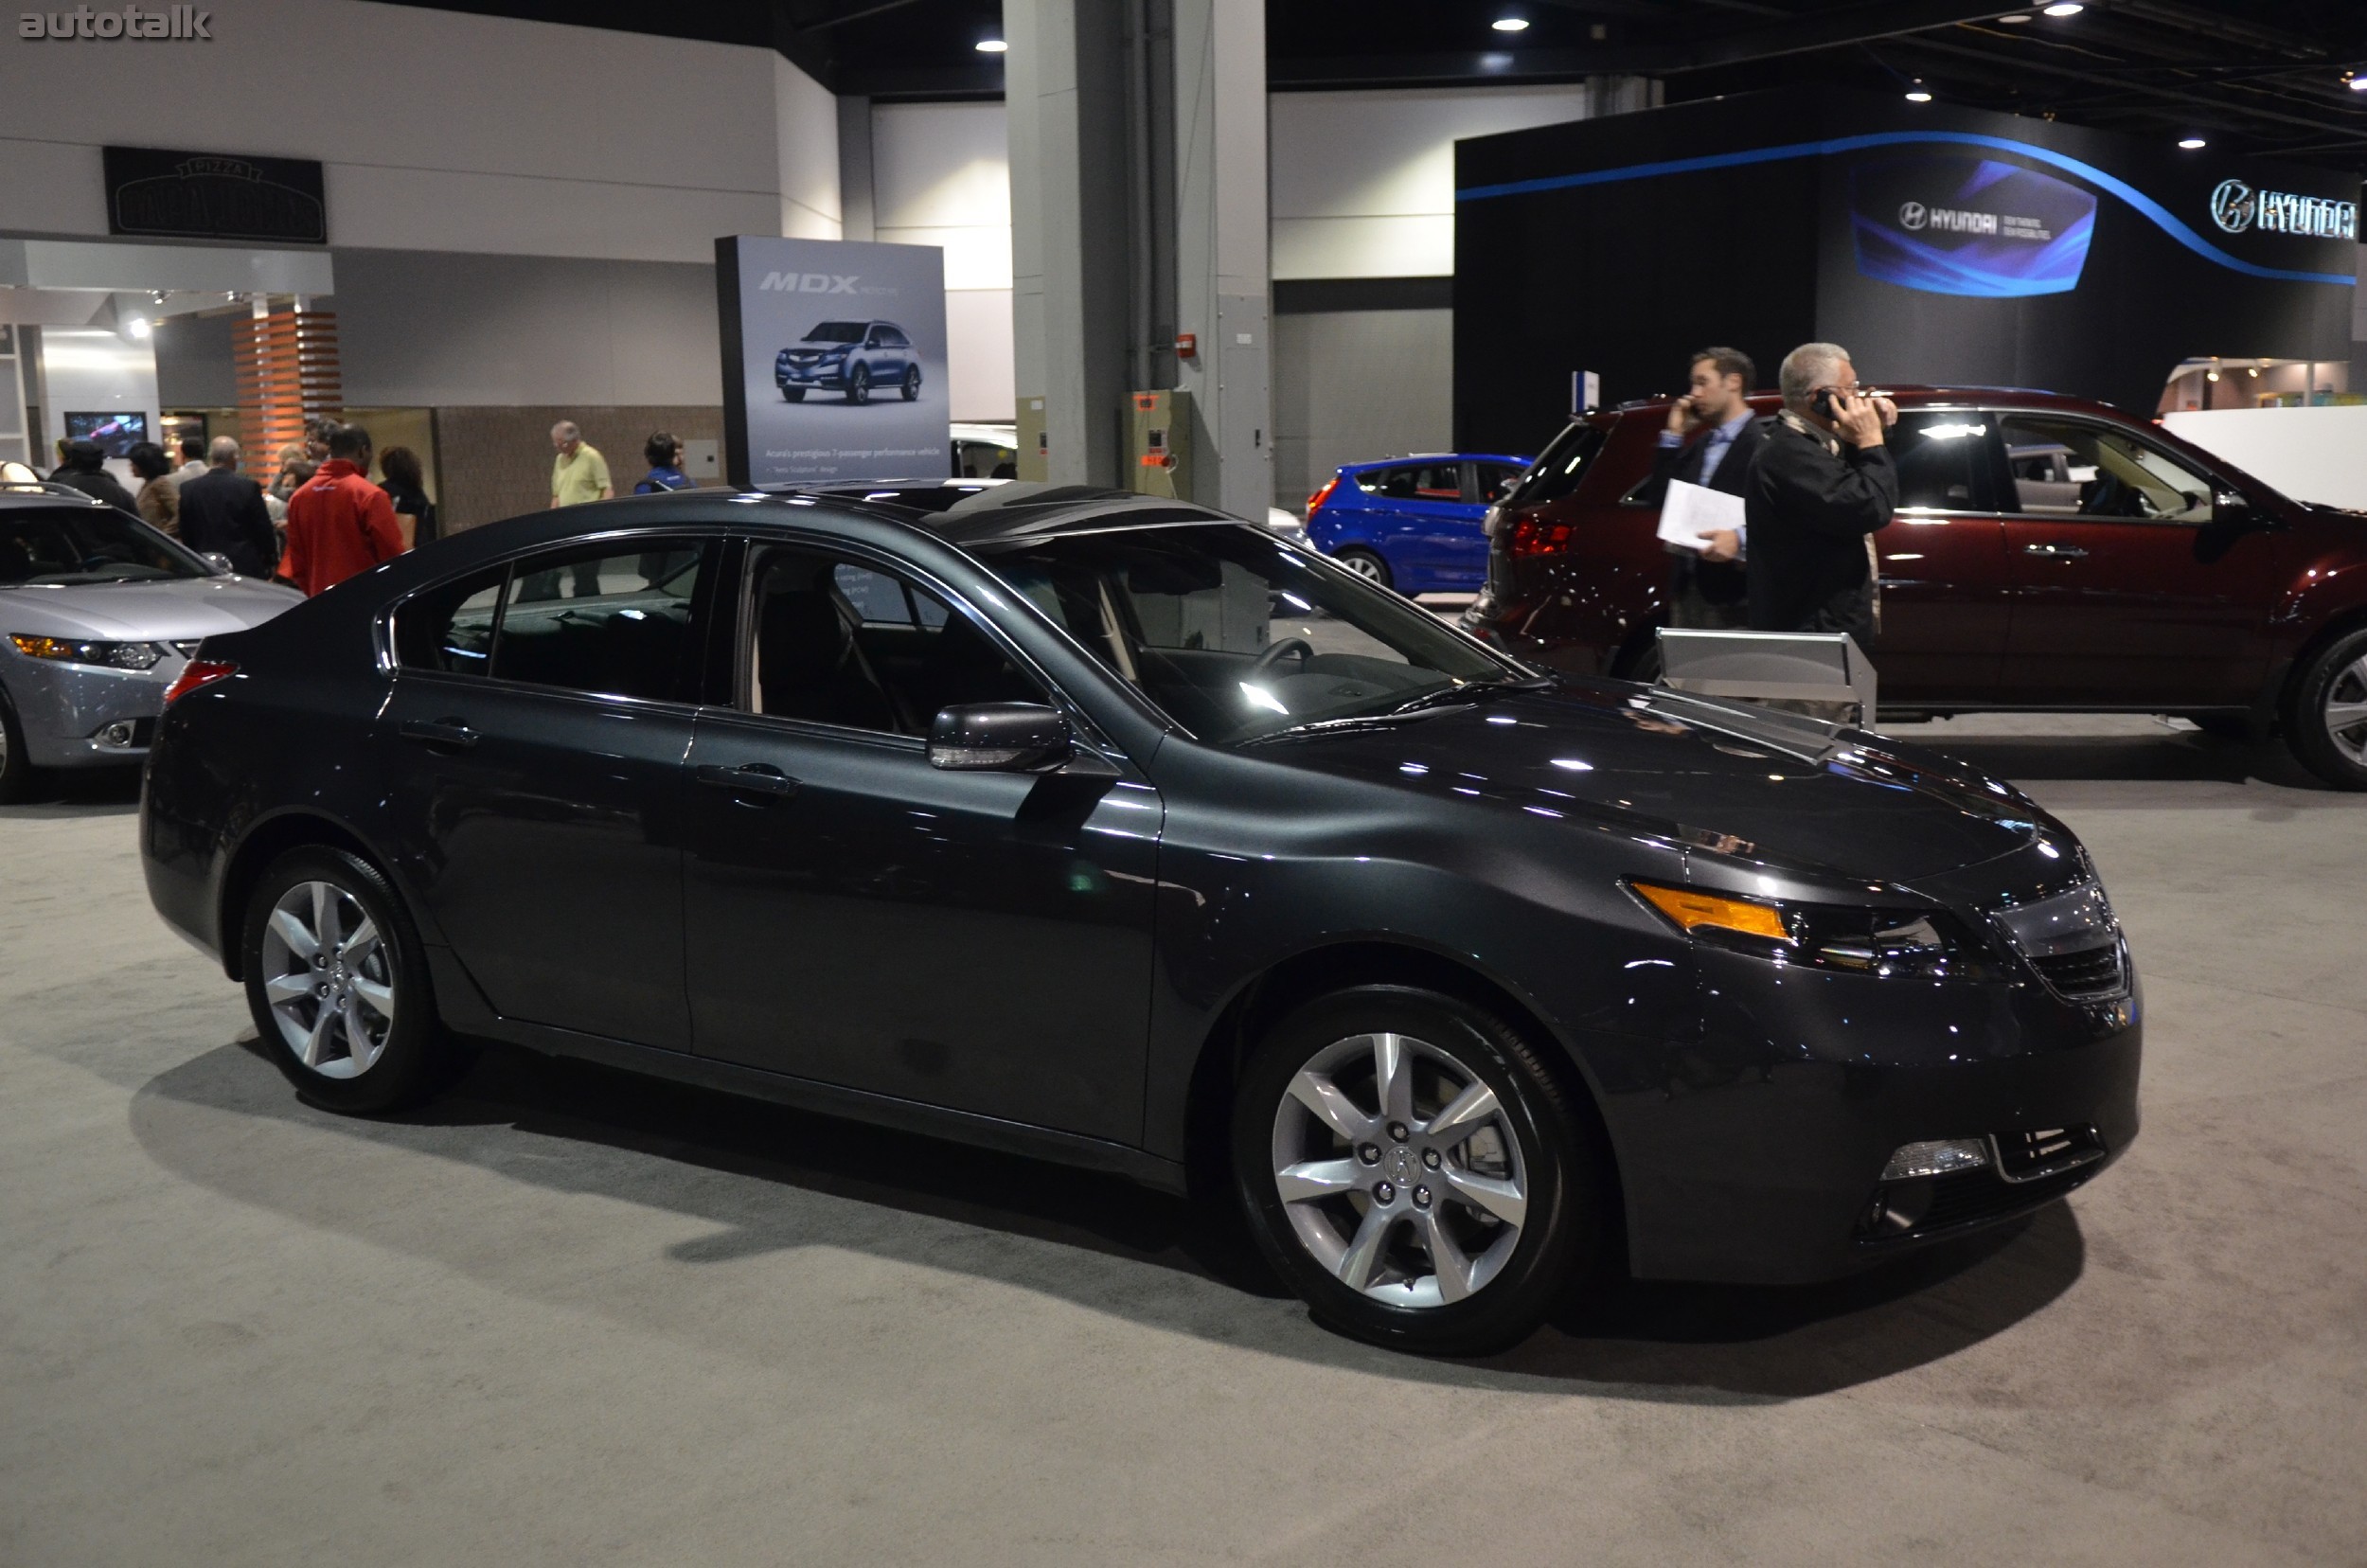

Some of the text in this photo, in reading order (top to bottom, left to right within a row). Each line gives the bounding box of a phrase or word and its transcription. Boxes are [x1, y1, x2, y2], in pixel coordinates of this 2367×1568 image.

[195, 160, 243, 174] PIZZA
[1930, 207, 1998, 235] HYUNDAI
[2257, 189, 2358, 239] HYUNDAI
[759, 271, 861, 294] MDX
[765, 446, 940, 460] Acura's prestigious 7-passenger performance vehicle
